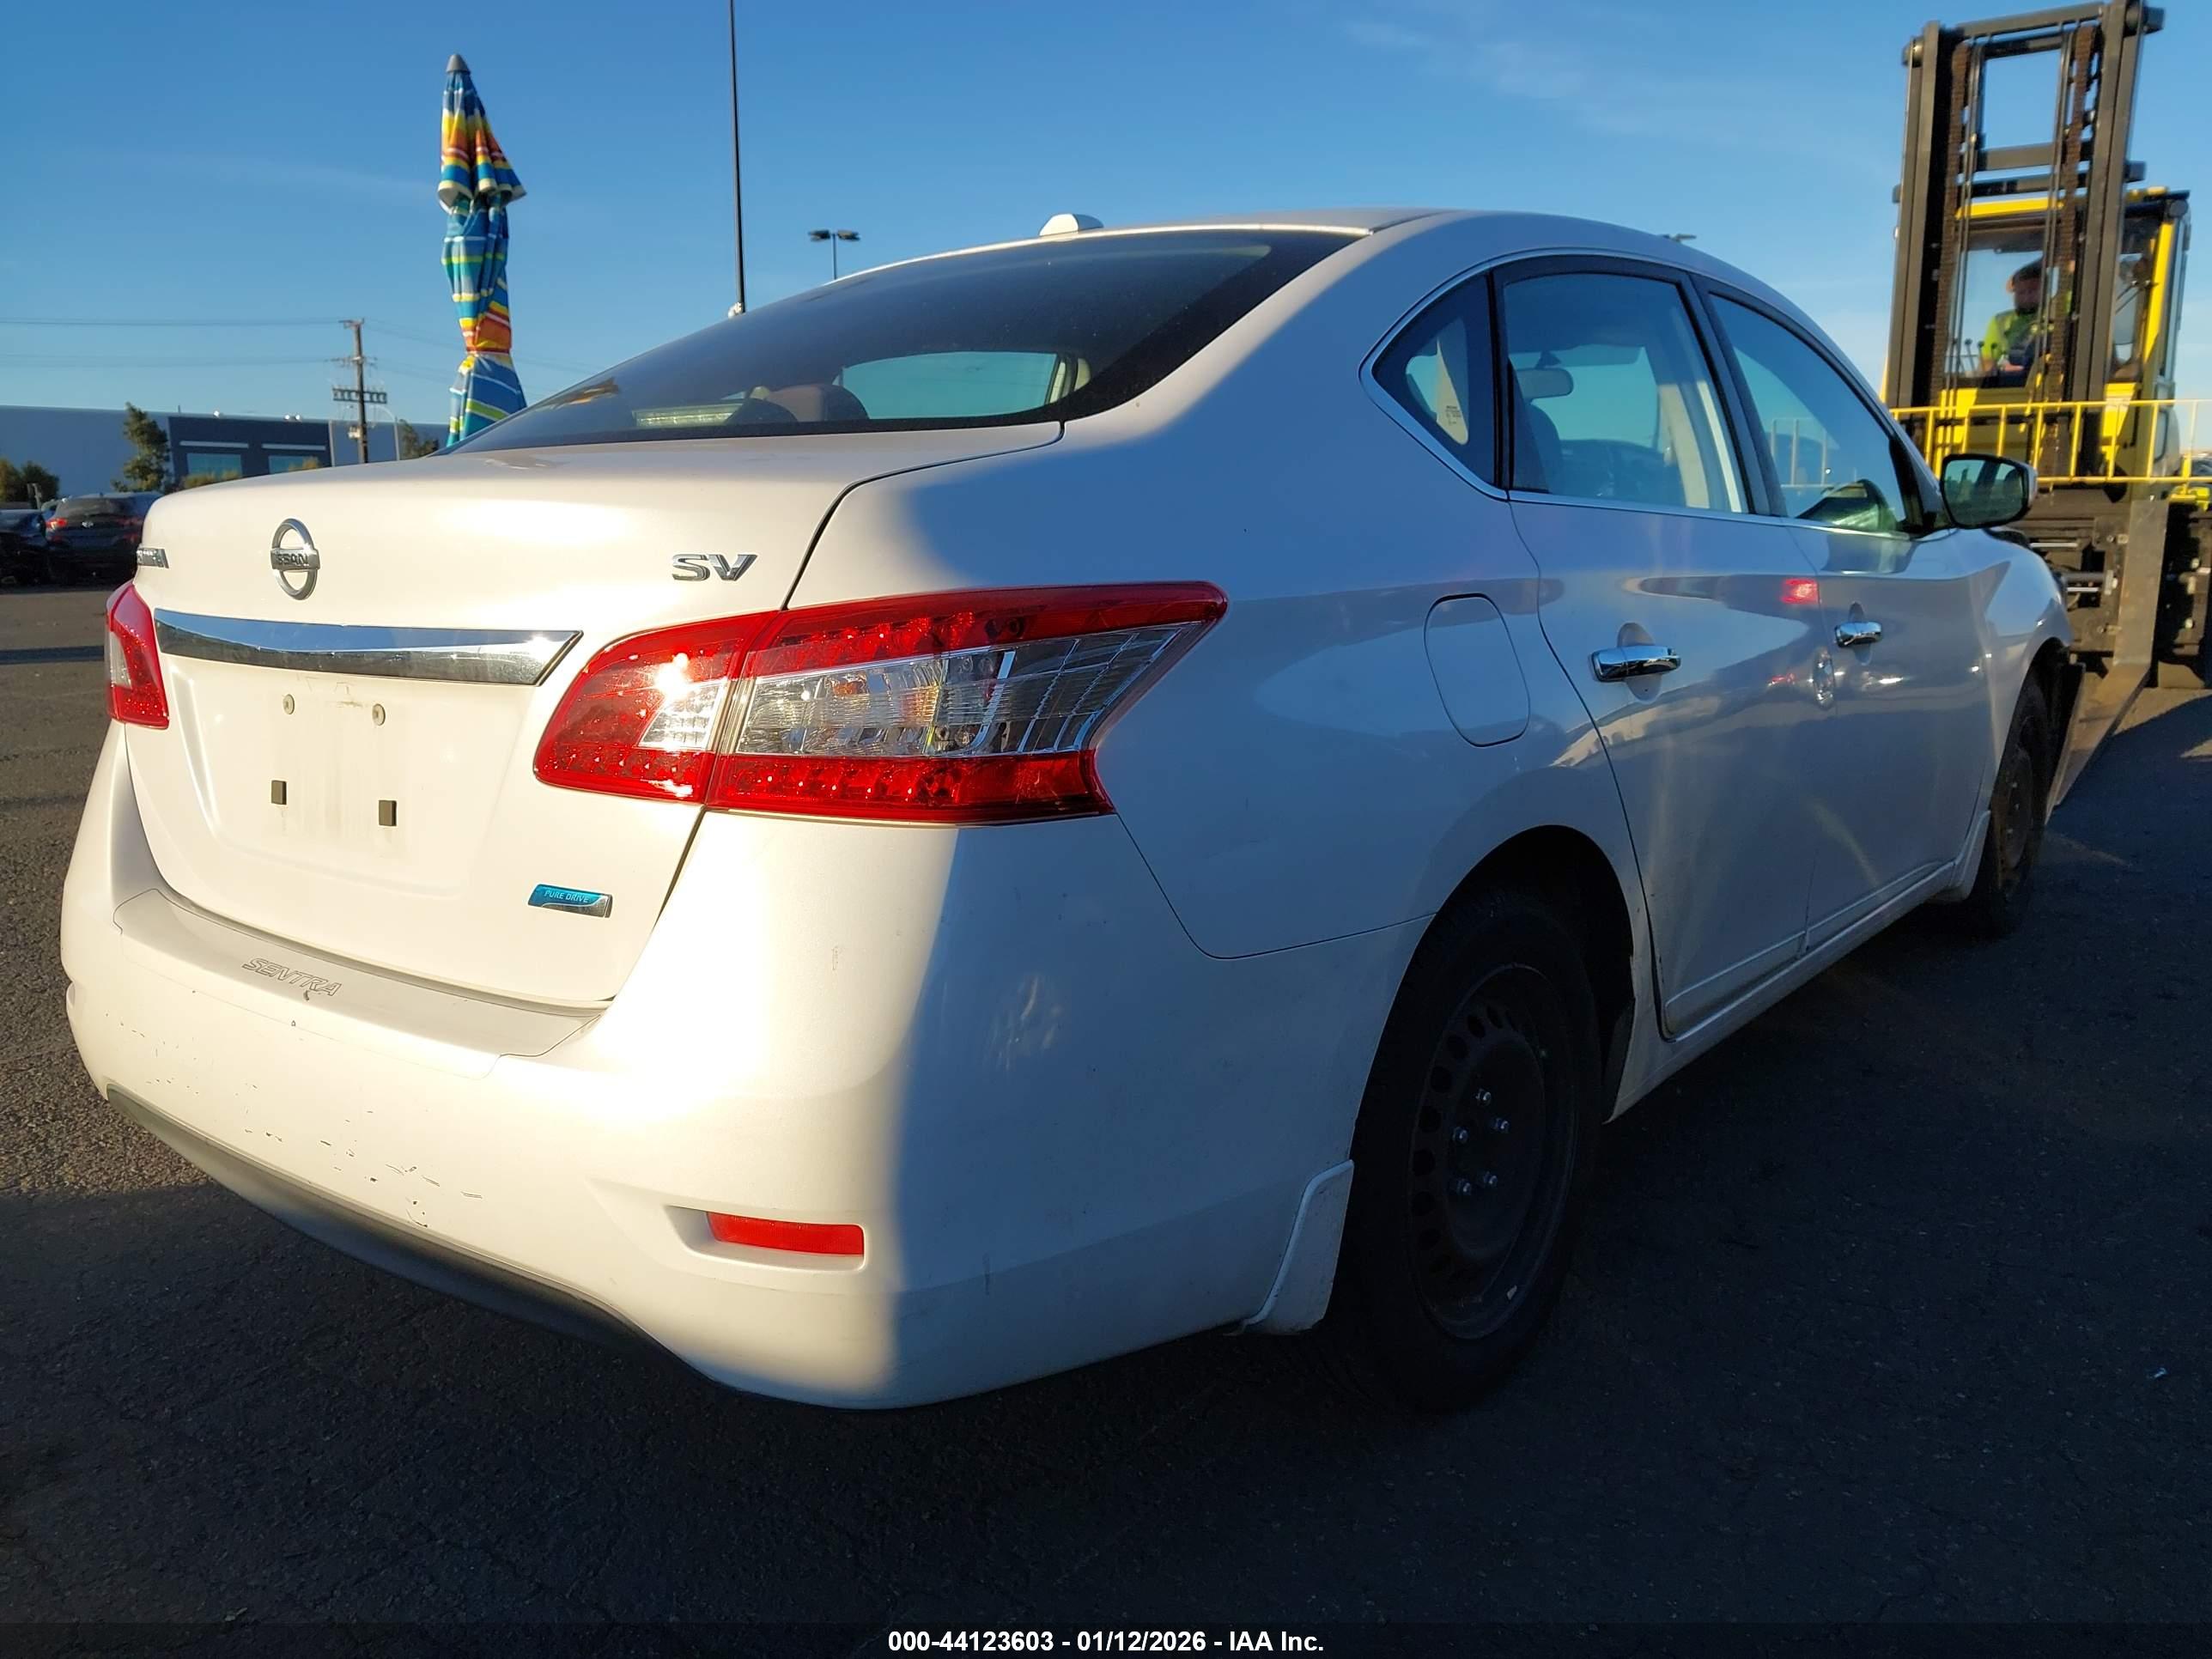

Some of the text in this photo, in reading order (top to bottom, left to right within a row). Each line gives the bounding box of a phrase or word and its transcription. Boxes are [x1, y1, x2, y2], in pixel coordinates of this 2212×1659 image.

[672, 554, 758, 581] SV
[544, 890, 590, 903] PURE DRIVE
[241, 957, 343, 997] SENTRA
